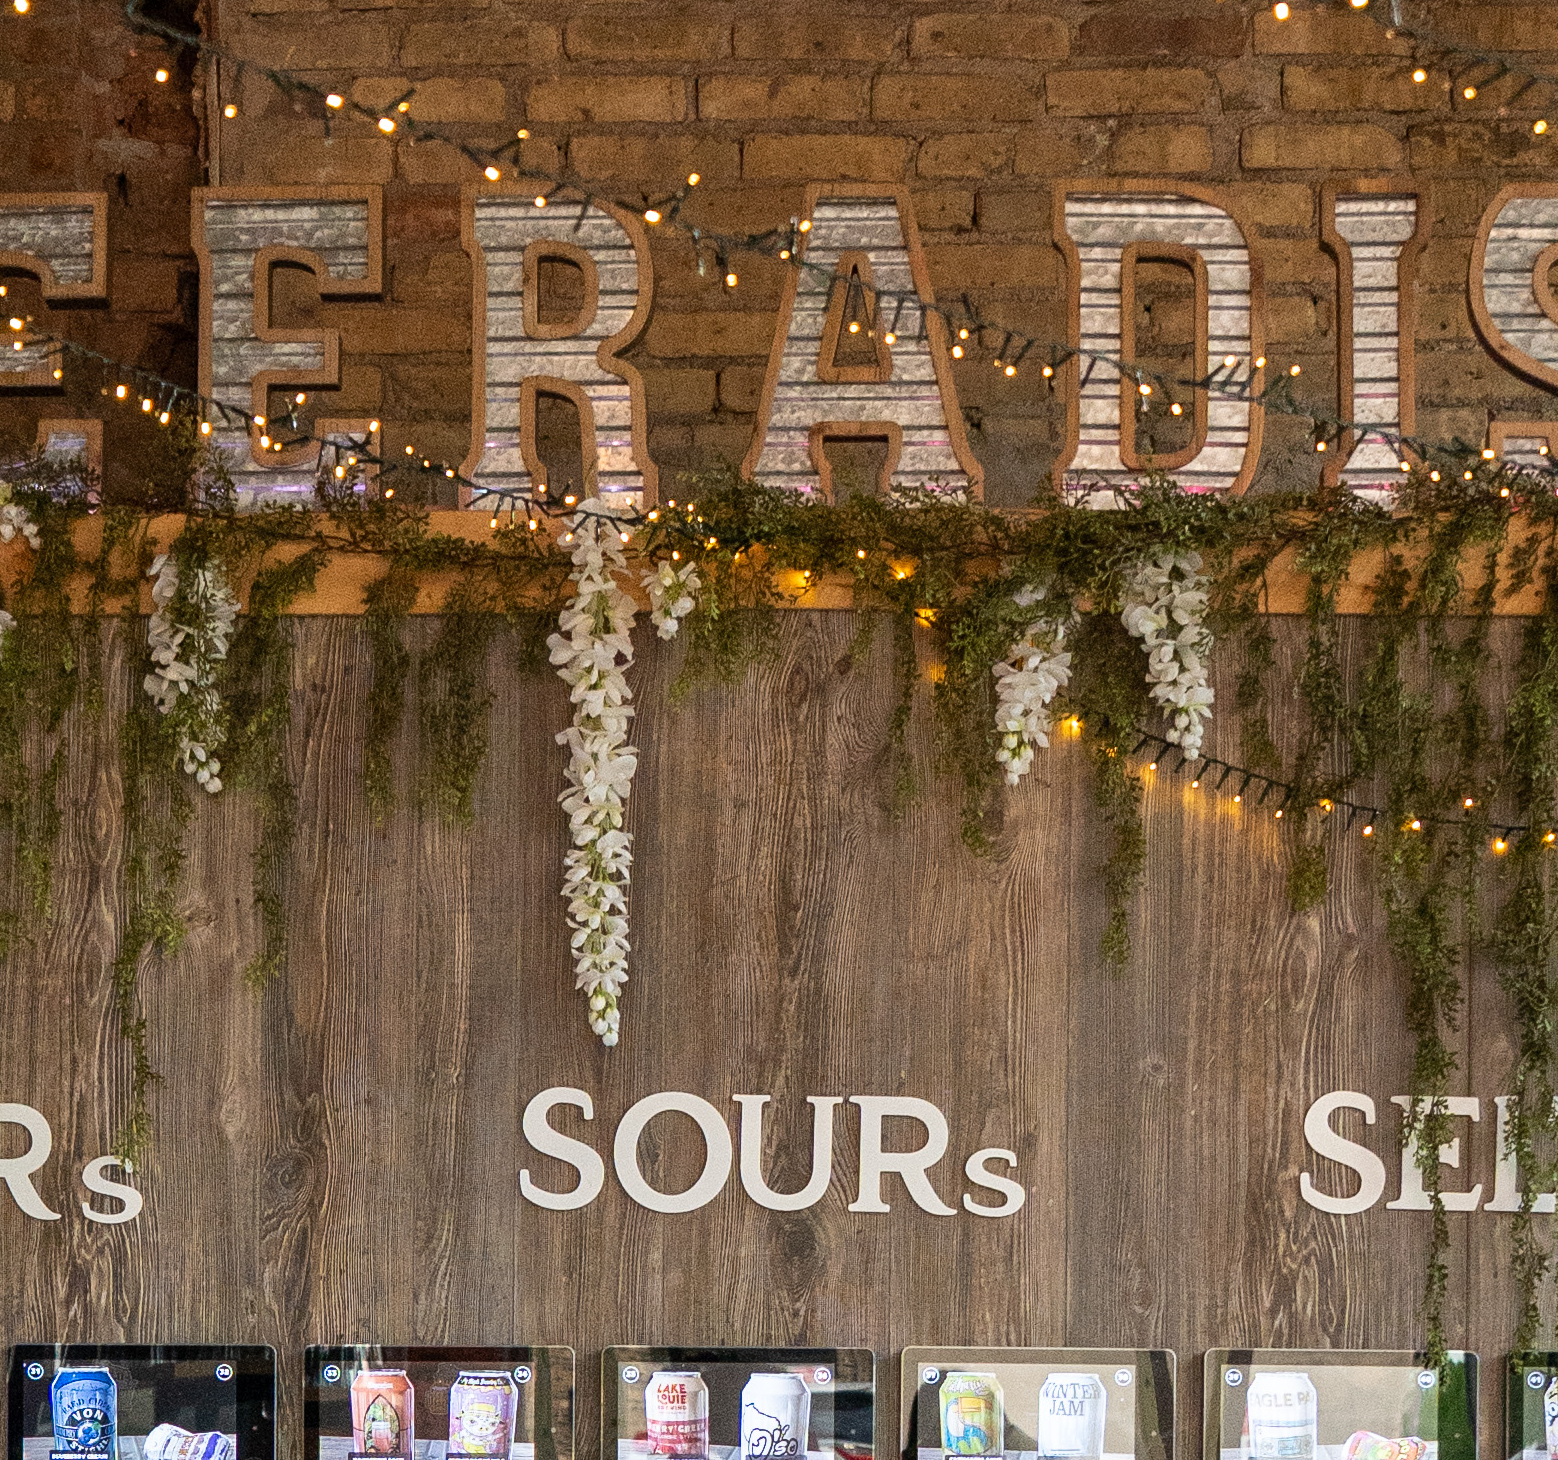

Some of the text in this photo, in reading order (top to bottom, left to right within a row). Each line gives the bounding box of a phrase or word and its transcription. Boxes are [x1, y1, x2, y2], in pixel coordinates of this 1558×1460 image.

[657, 1383, 687, 1394] LAKE
[657, 1393, 687, 1405] LOUIE
[1049, 1399, 1085, 1416] JAM
[72, 1408, 104, 1421] VON
